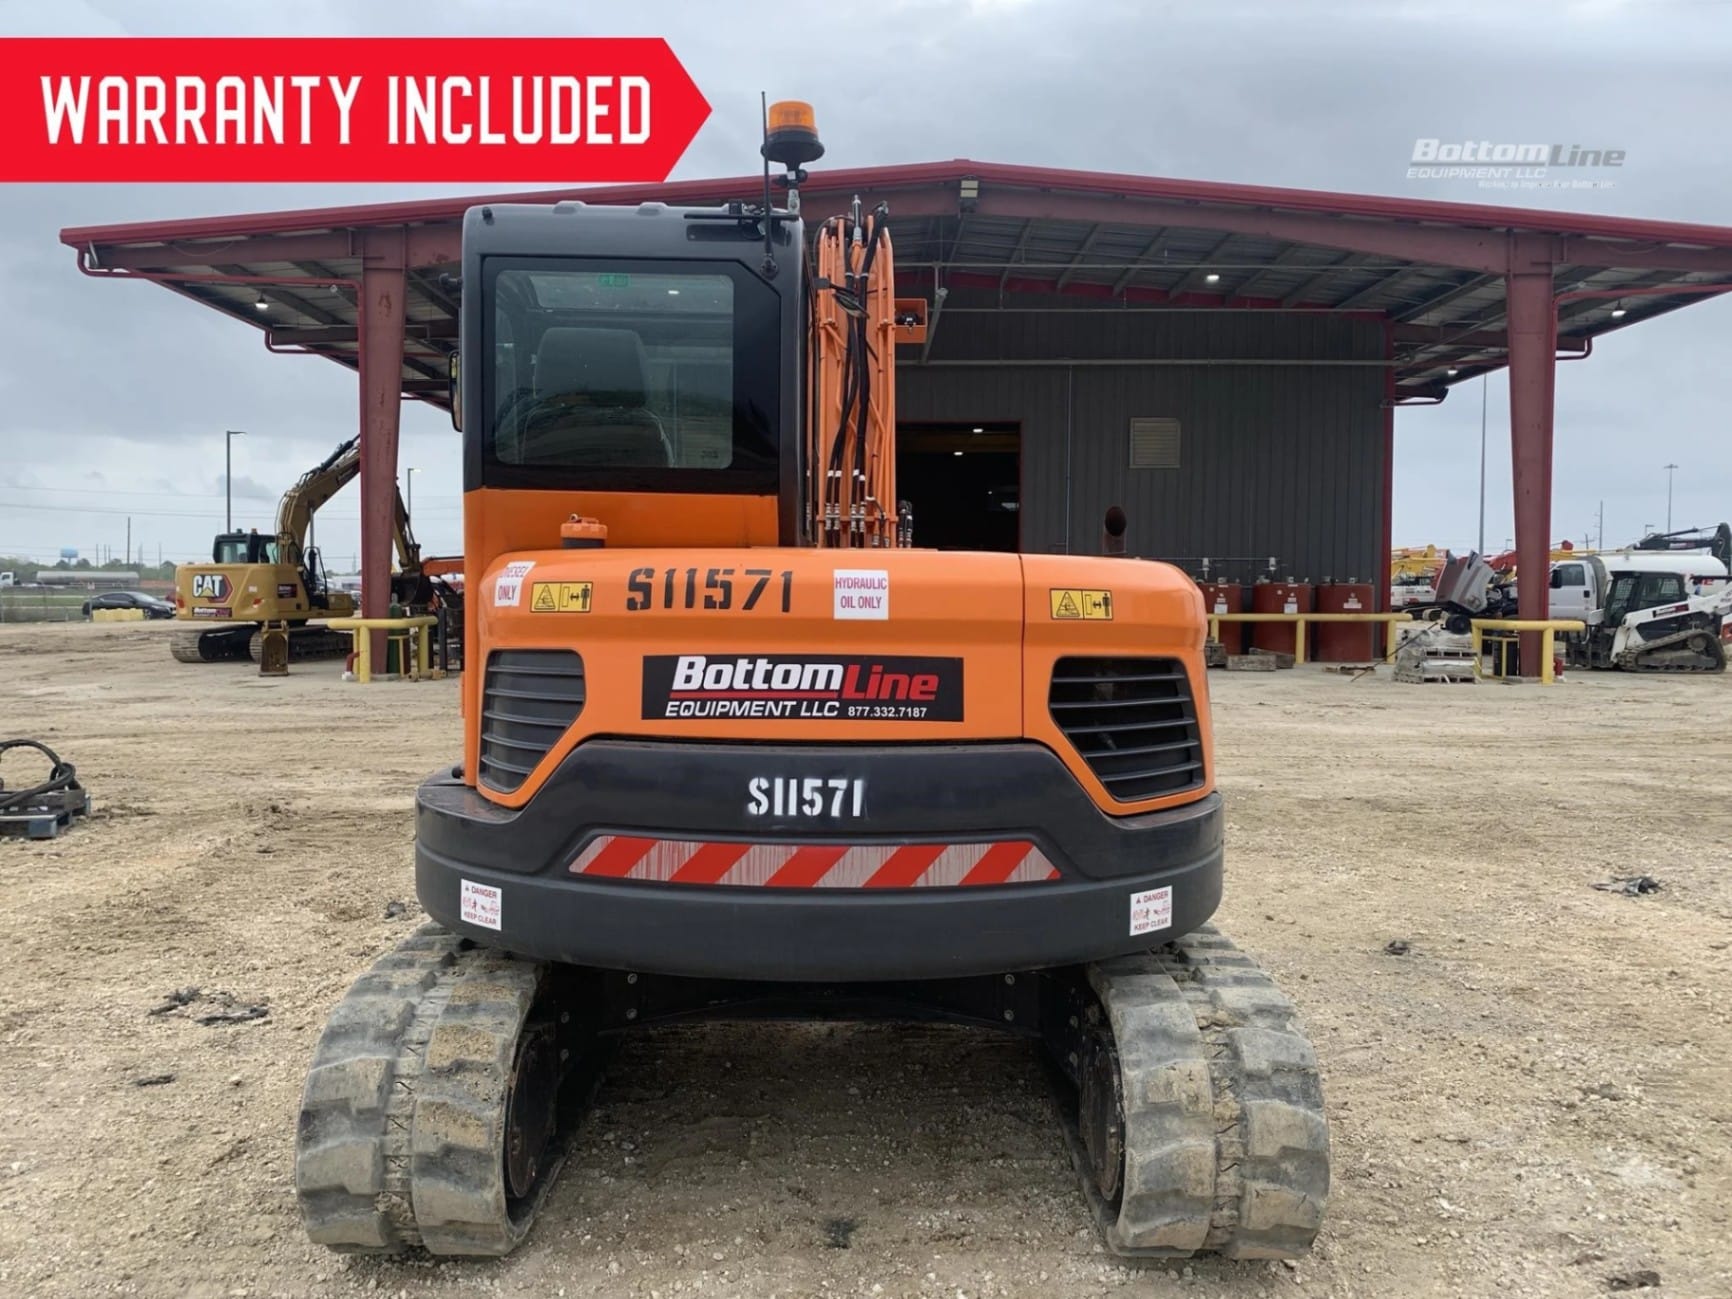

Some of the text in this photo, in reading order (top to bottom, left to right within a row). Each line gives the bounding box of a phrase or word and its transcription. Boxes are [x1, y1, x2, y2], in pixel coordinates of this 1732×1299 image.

[193, 575, 223, 597] CAT
[626, 567, 793, 613] S11571
[835, 577, 888, 591] HYDRAULIC
[498, 585, 517, 601] ONLY
[840, 595, 882, 609] OIL ONLY
[665, 701, 927, 719] EQUIPMENT LLC 877.332.7187
[748, 777, 863, 817] S11571
[471, 886, 497, 899] DANGER
[1143, 890, 1169, 903] DANGER
